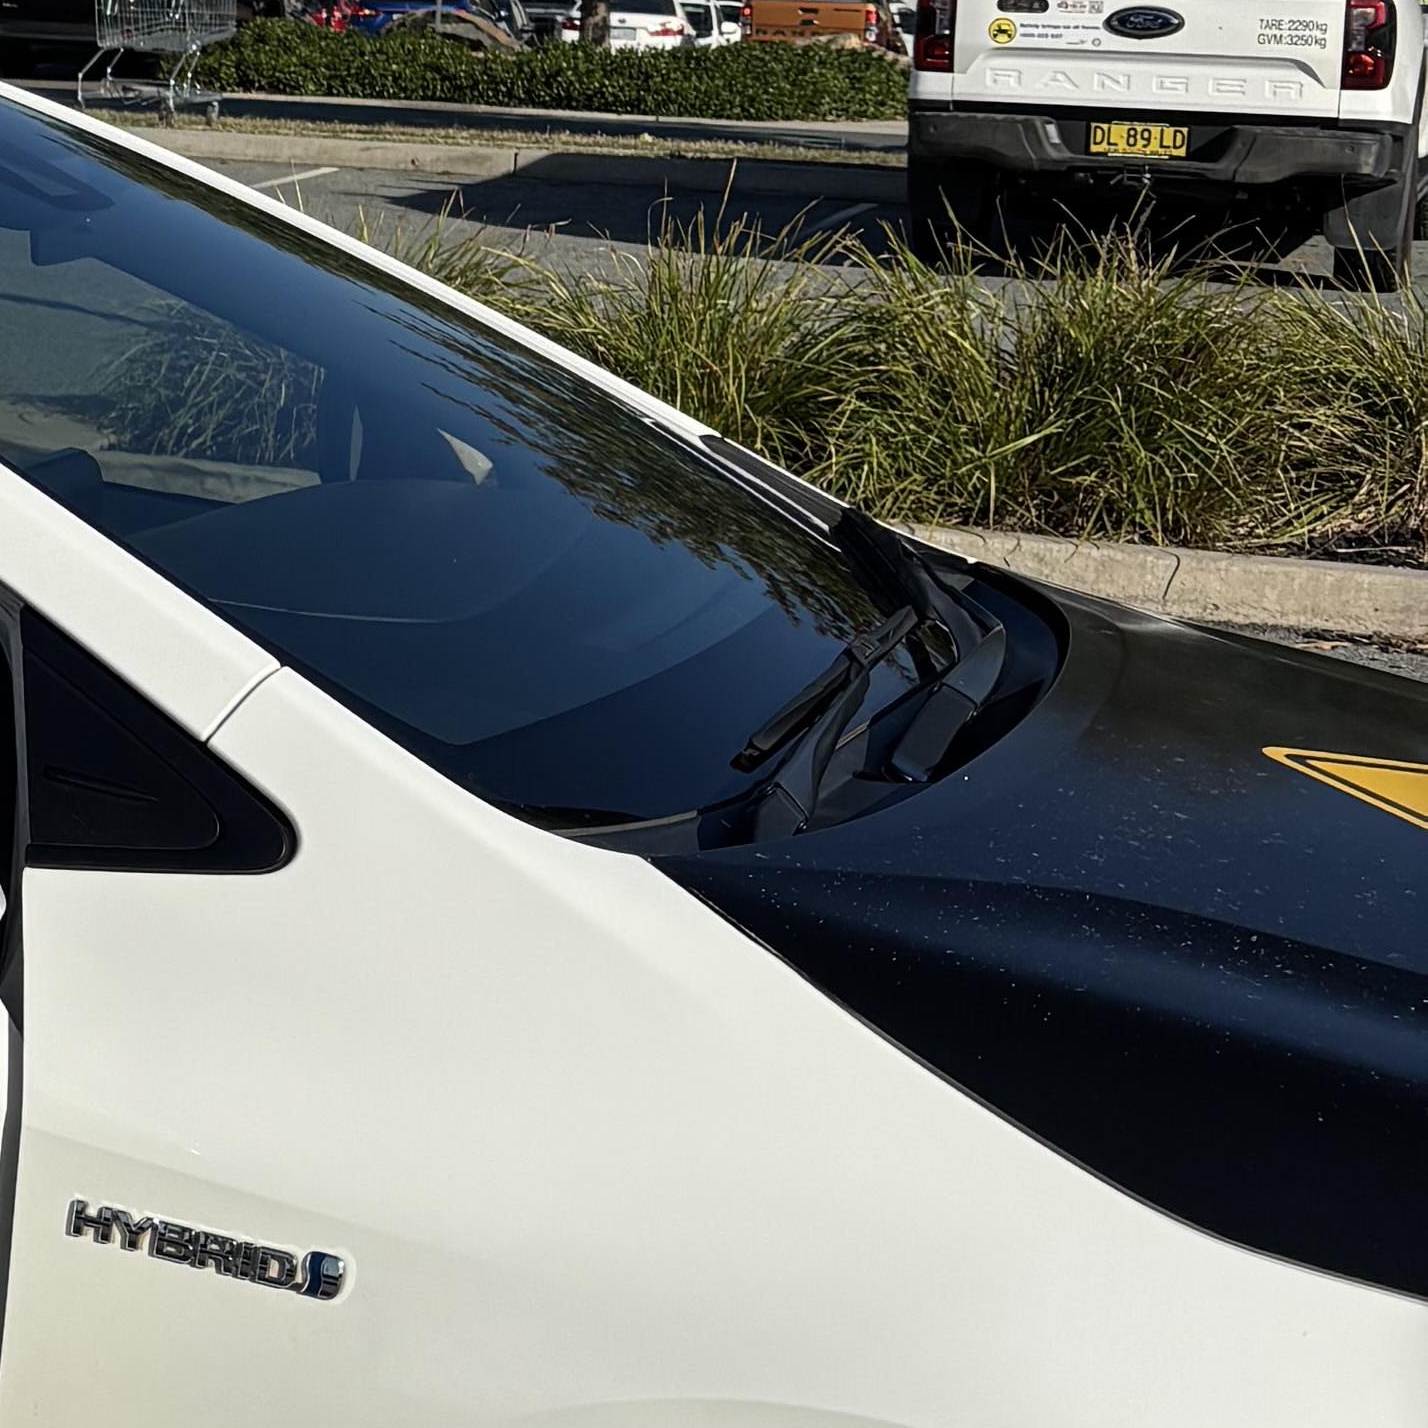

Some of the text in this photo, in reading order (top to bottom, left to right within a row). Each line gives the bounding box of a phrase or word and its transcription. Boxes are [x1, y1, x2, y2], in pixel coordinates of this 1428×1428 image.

[984, 68, 1304, 100] RANGER
[1093, 125, 1186, 149] DL 89 LD
[65, 1198, 298, 1291] HYBRID
